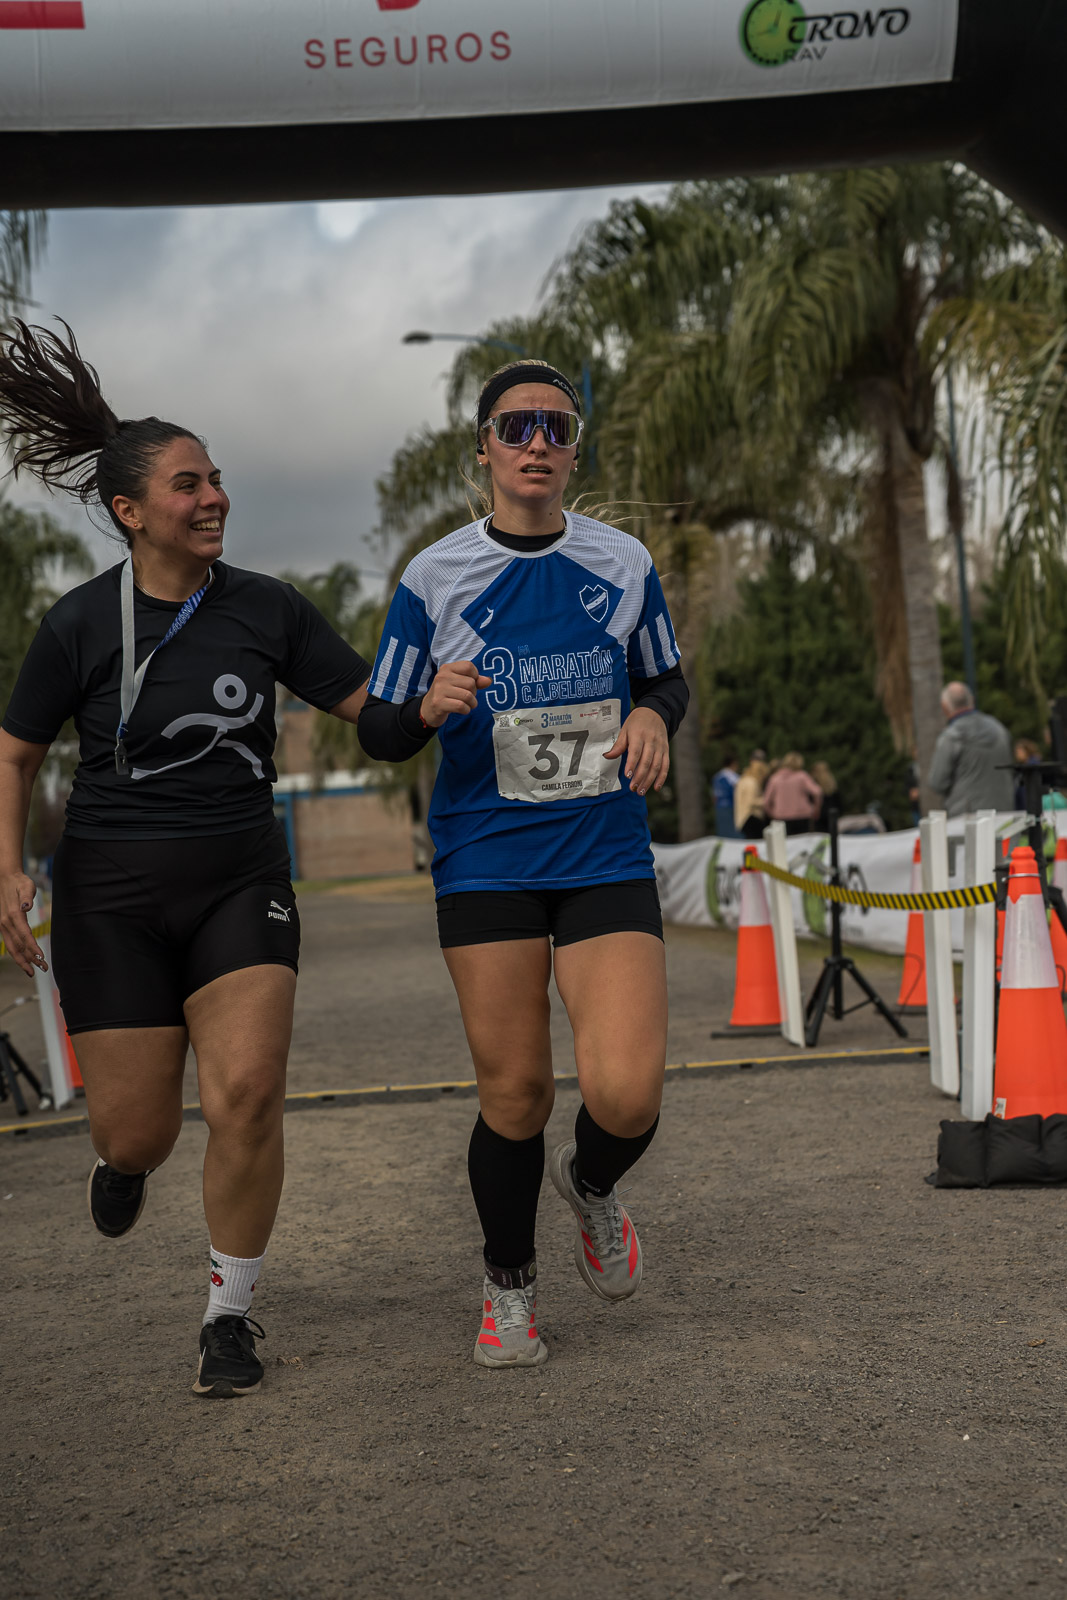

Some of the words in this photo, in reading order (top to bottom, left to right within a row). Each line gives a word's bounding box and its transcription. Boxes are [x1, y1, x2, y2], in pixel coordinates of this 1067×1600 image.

[788, 8, 910, 43] CRONO
[304, 31, 512, 69] SEGUROS
[483, 647, 517, 713] 3
[519, 646, 613, 684] MARATÓN
[541, 713, 549, 728] 3
[528, 730, 589, 780] 37
[541, 783, 561, 791] CAMILA
[267, 911, 287, 922] PUMA
